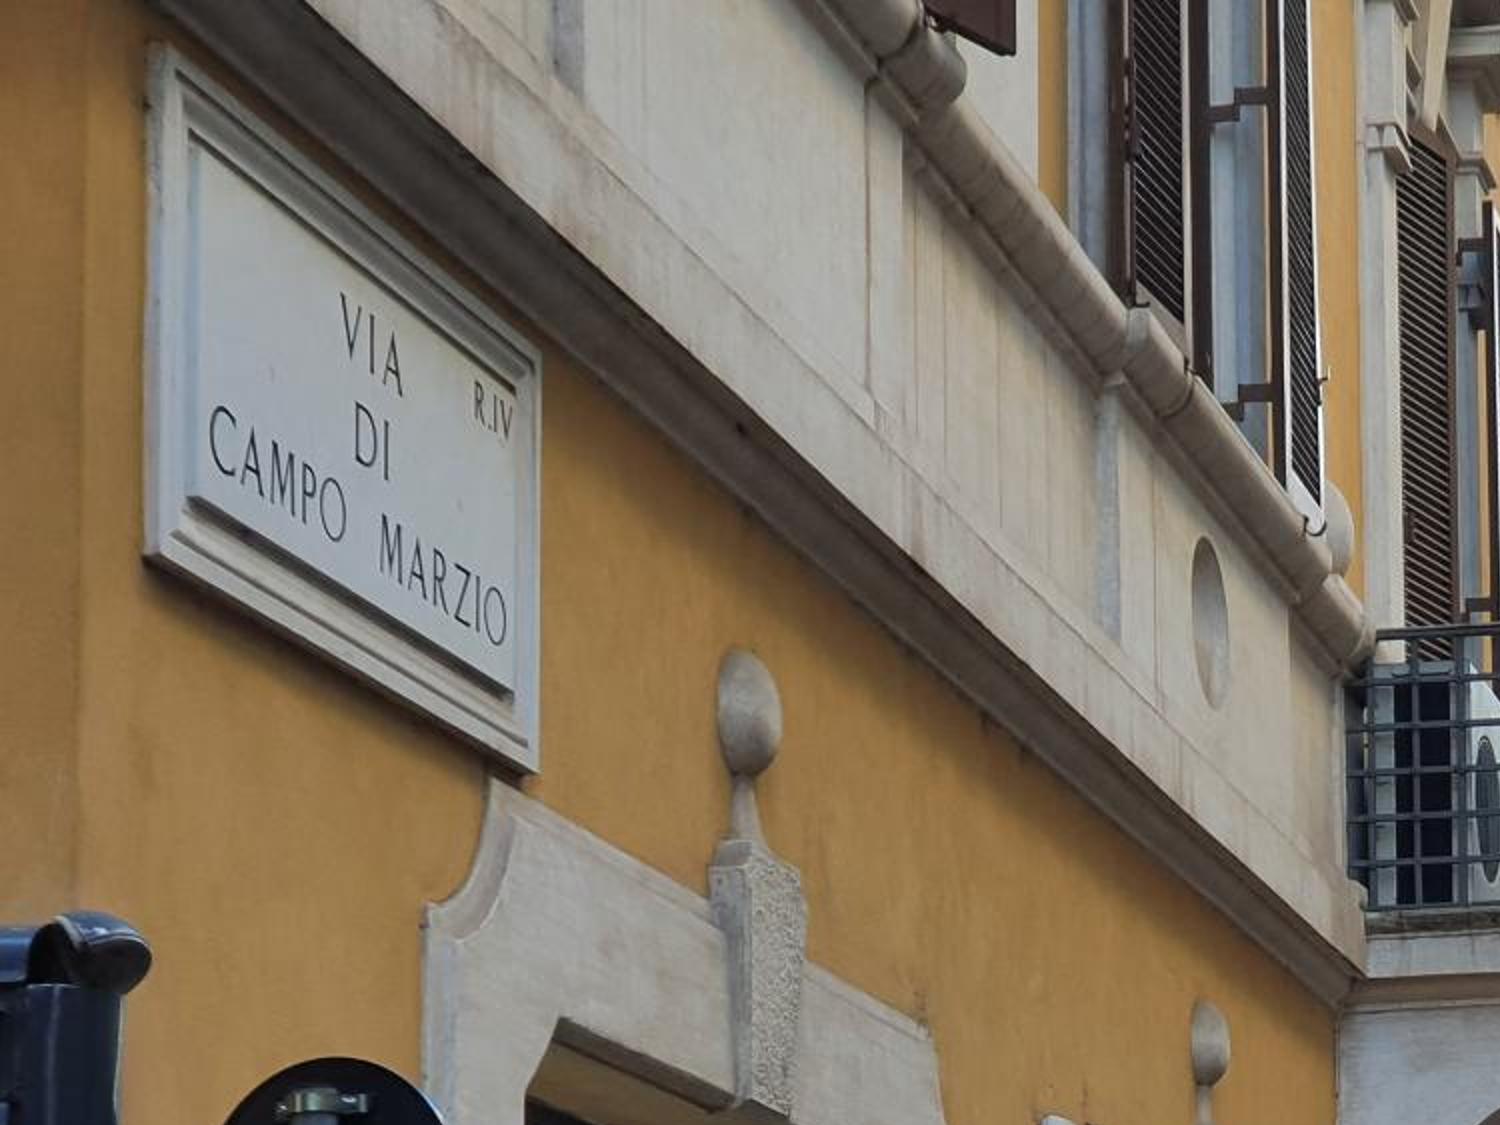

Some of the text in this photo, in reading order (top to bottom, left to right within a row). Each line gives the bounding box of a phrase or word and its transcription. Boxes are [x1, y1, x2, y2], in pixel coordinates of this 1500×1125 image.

[340, 291, 403, 397] VIA
[355, 401, 389, 481] DI
[210, 405, 507, 646] CAMPO MARZIO
